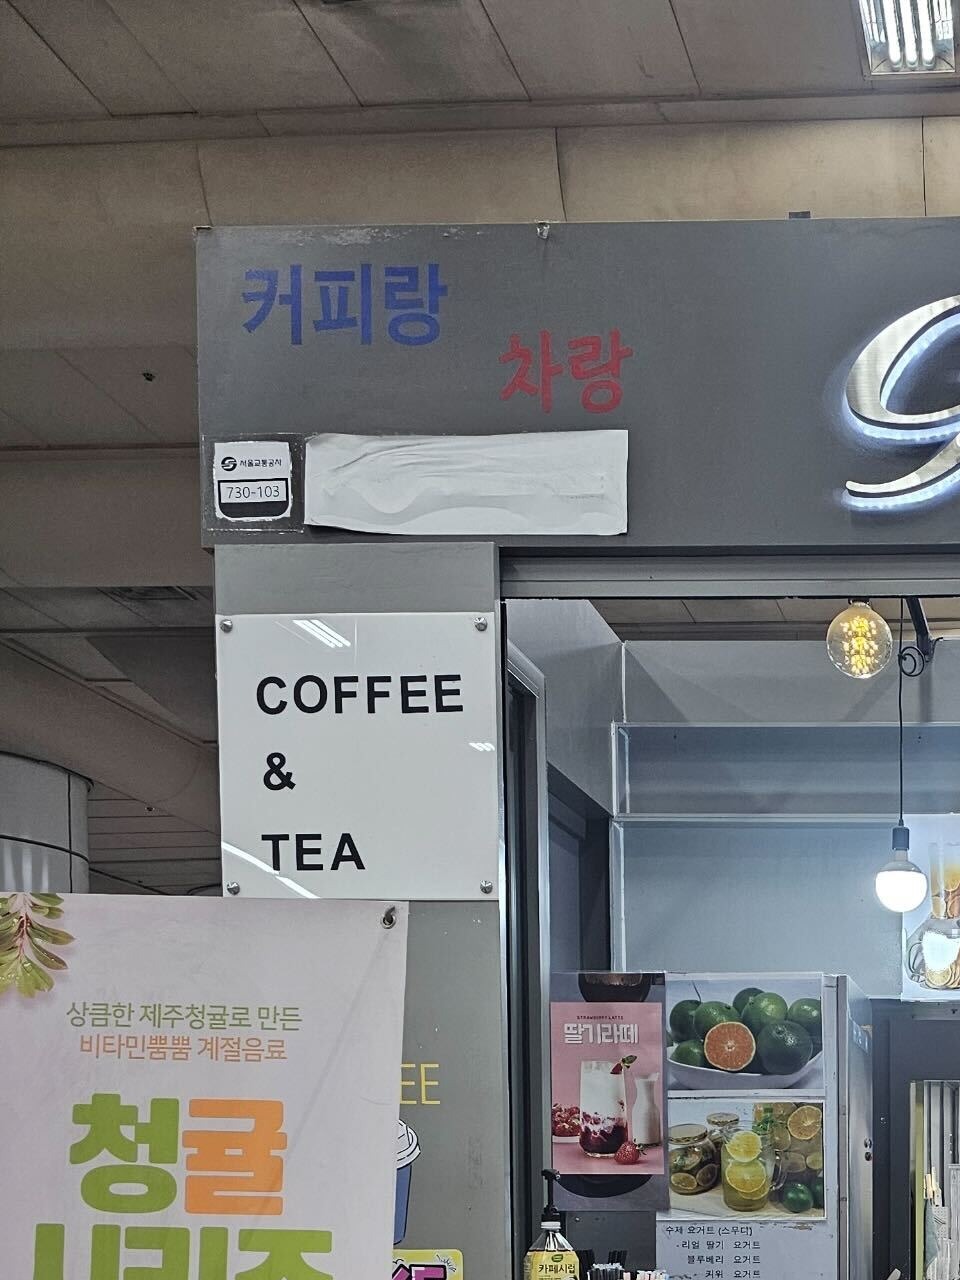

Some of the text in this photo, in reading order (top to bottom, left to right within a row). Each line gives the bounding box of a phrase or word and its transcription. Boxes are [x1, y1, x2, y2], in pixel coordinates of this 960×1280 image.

[241, 263, 448, 345] 커피랑
[499, 328, 633, 413] 차랑
[226, 485, 280, 499] 730-103
[256, 674, 463, 715] COFFEE
[263, 752, 296, 790] &
[261, 832, 366, 871] TEA
[66, 1002, 303, 1031] 상큼한 제주청귤로 만든
[564, 1023, 639, 1044] 딸기라떼
[79, 1034, 288, 1062] 비타민뿜뿜 계절음료
[69, 1093, 288, 1216] 청귤
[665, 1226, 683, 1235] 수제
[687, 1226, 716, 1235] 요거트
[681, 1240, 761, 1250] 리얼 딸기 요거트
[538, 1263, 576, 1274] 카페시럽
[687, 1255, 761, 1265] 블루베리 요거트
[733, 1270, 761, 1279] 요거트
